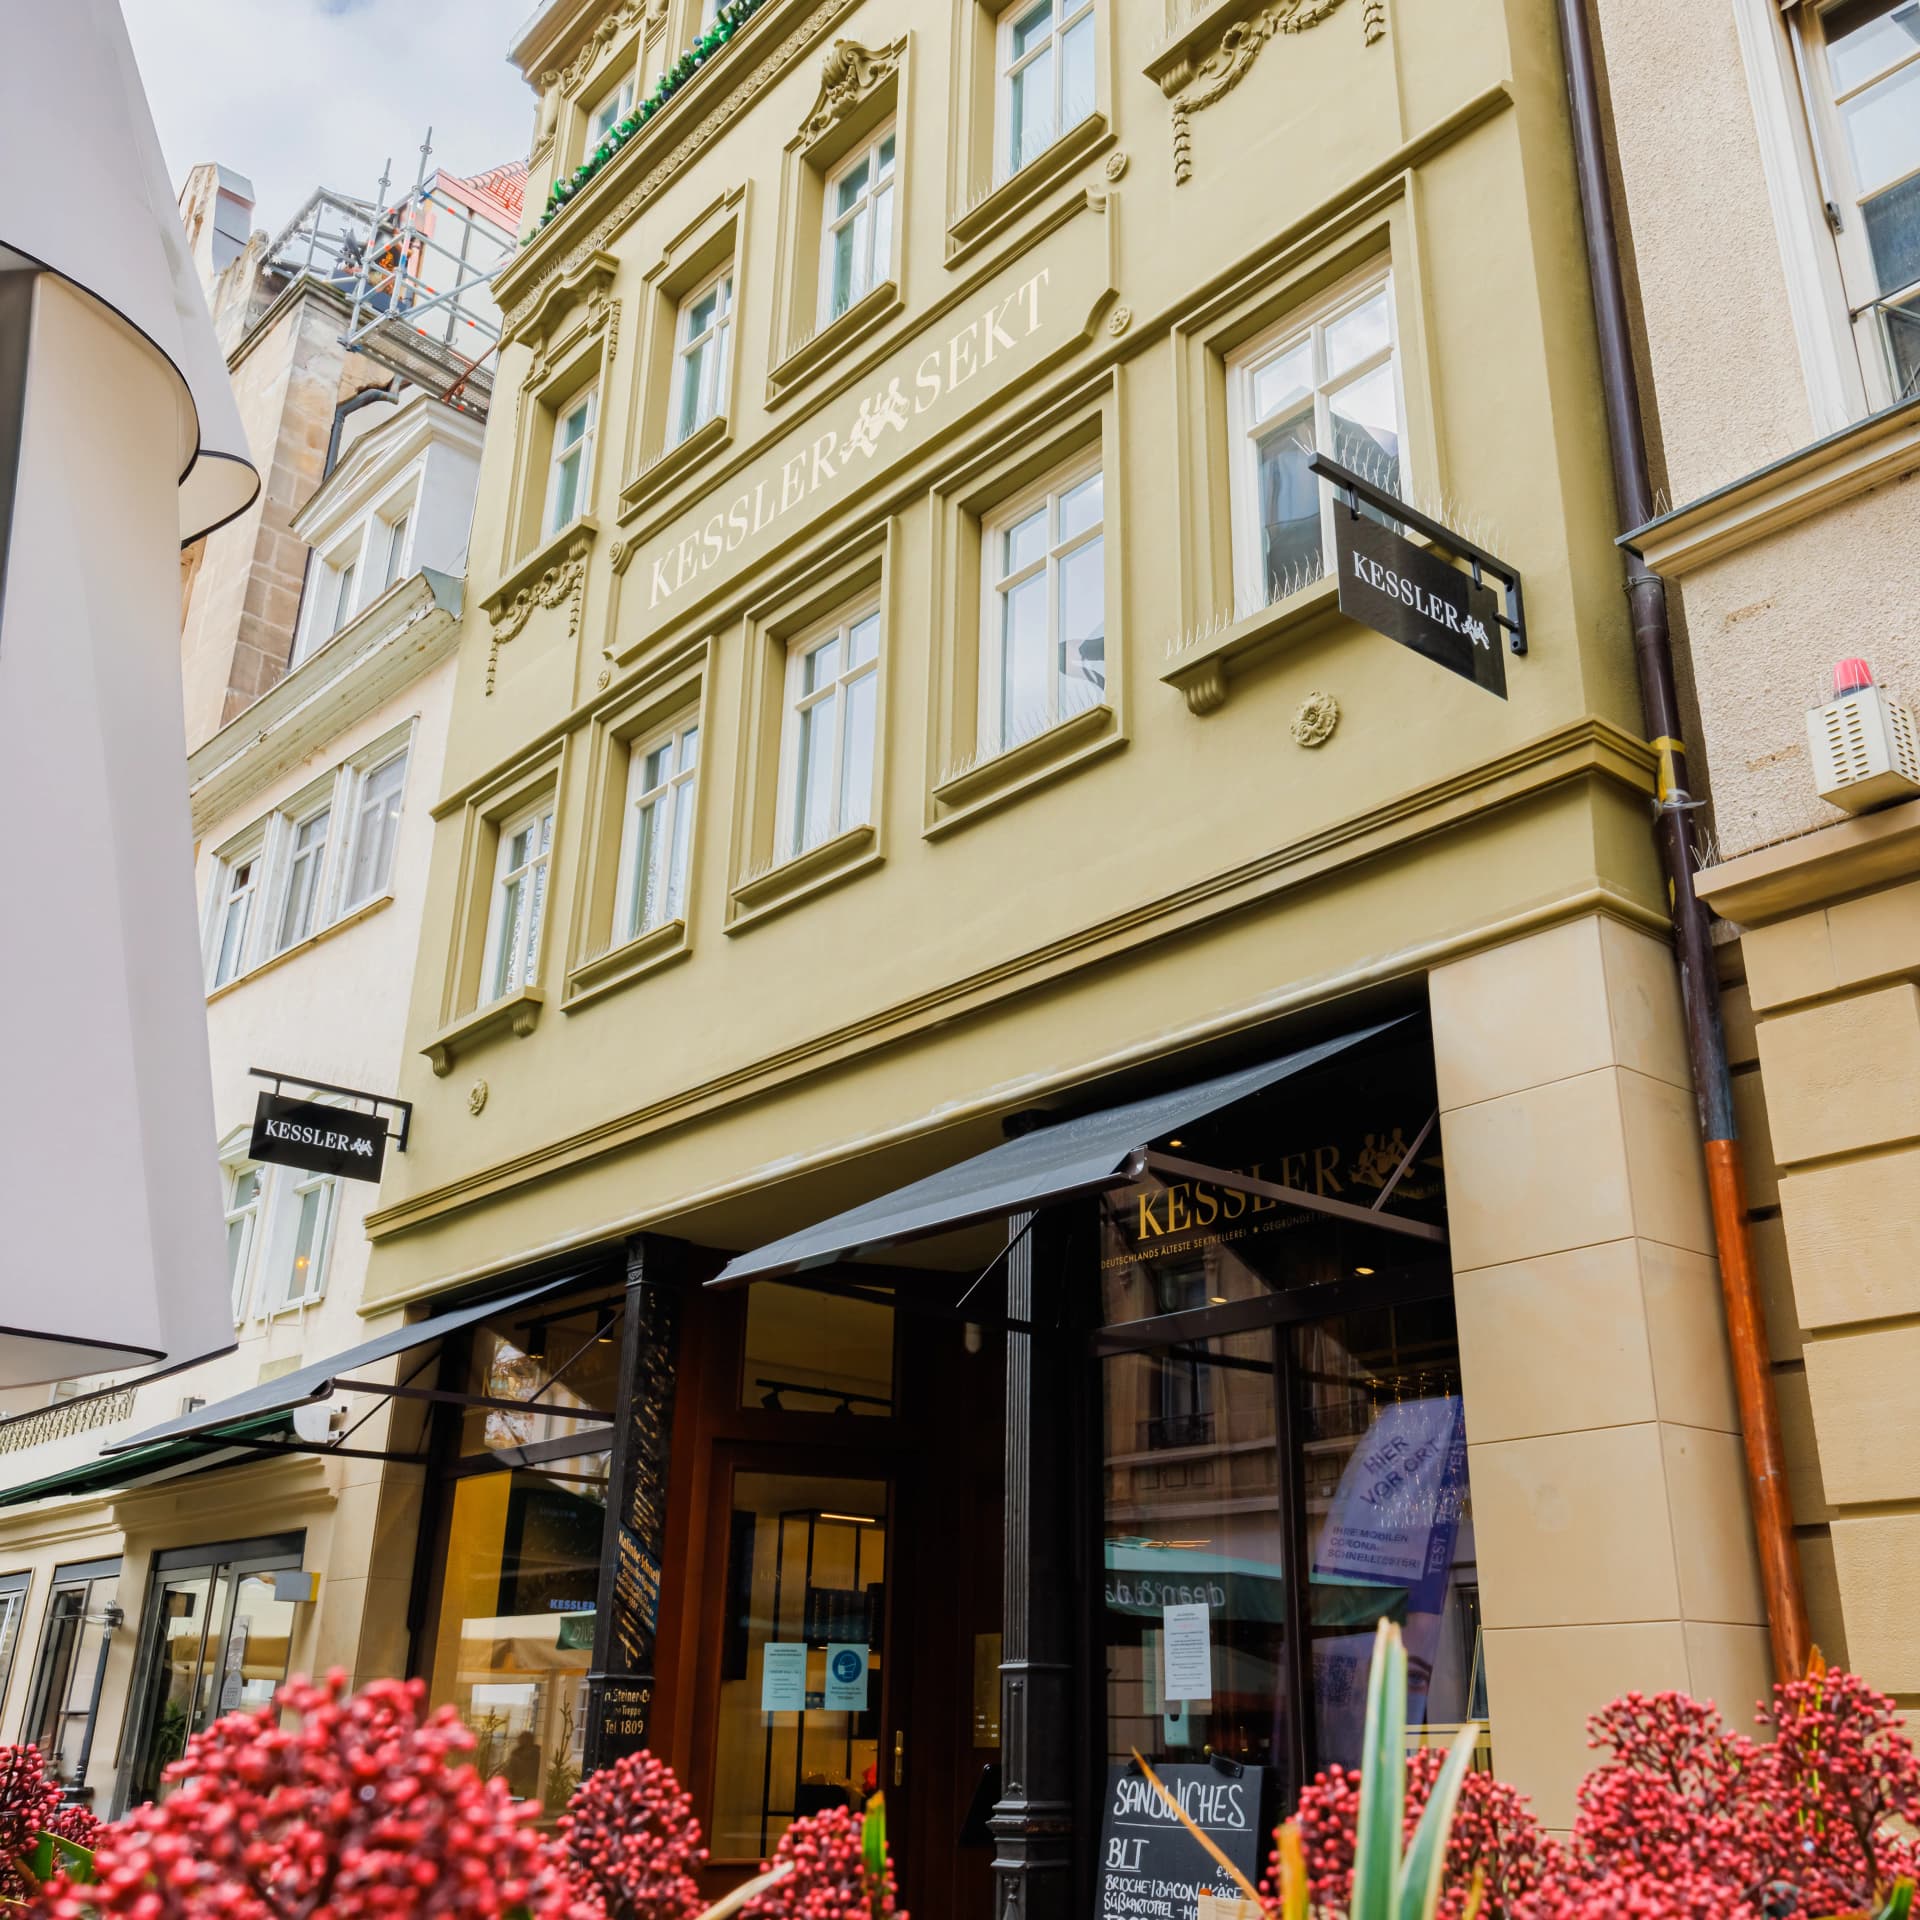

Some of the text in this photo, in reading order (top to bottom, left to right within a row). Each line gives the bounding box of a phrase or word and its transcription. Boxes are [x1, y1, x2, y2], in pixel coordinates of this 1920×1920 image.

[648, 268, 1051, 610] KESSLER SEKT
[1353, 551, 1460, 632] KESSLER
[265, 1120, 351, 1151] KESSLER
[1137, 1146, 1344, 1240] KESSLER
[1100, 1248, 1159, 1270] DEUTSCHLANDS
[1161, 1241, 1191, 1256] ÄLTESTE
[1364, 1435, 1408, 1474] HIER
[1113, 1778, 1246, 1828] SANDWICHES
[1105, 1837, 1150, 1869] BLT
